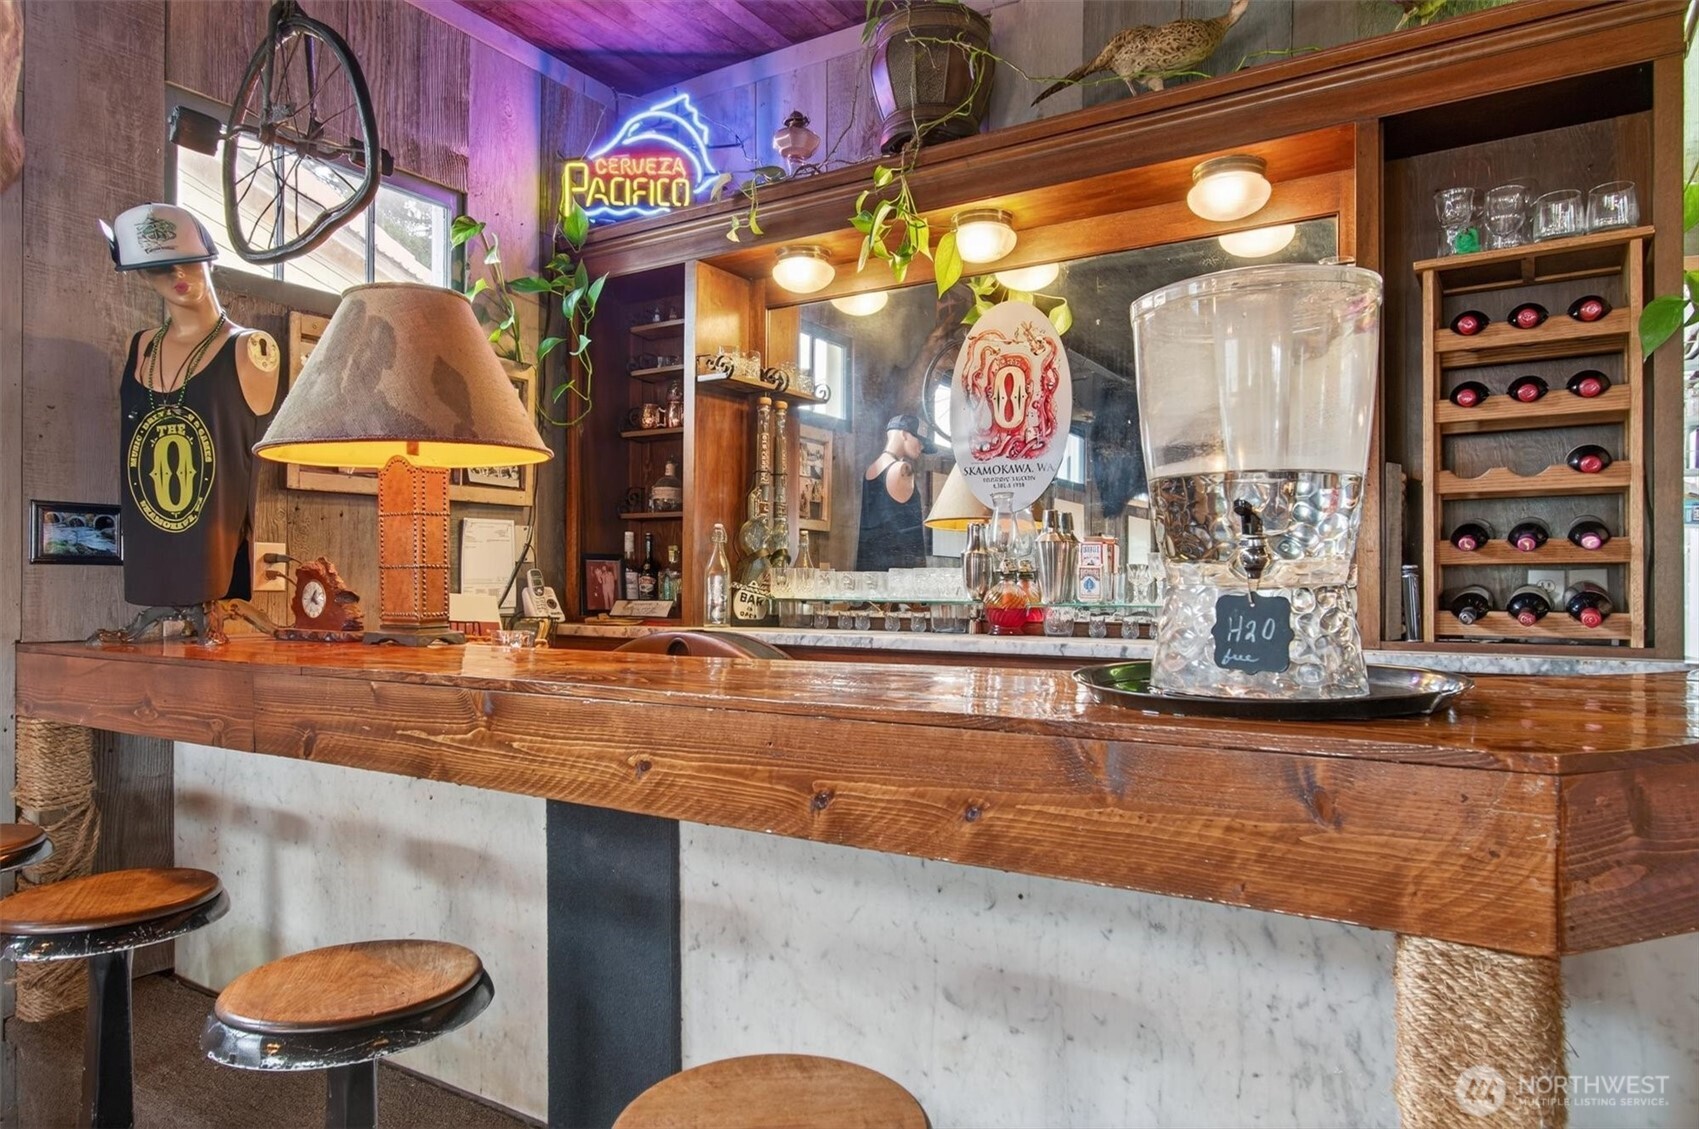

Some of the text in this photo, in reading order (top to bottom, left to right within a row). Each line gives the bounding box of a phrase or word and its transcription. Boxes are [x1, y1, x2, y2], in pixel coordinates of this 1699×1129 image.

[594, 157, 687, 177] CERVEZA
[564, 162, 690, 217] PACIFICO
[156, 423, 186, 437] THE
